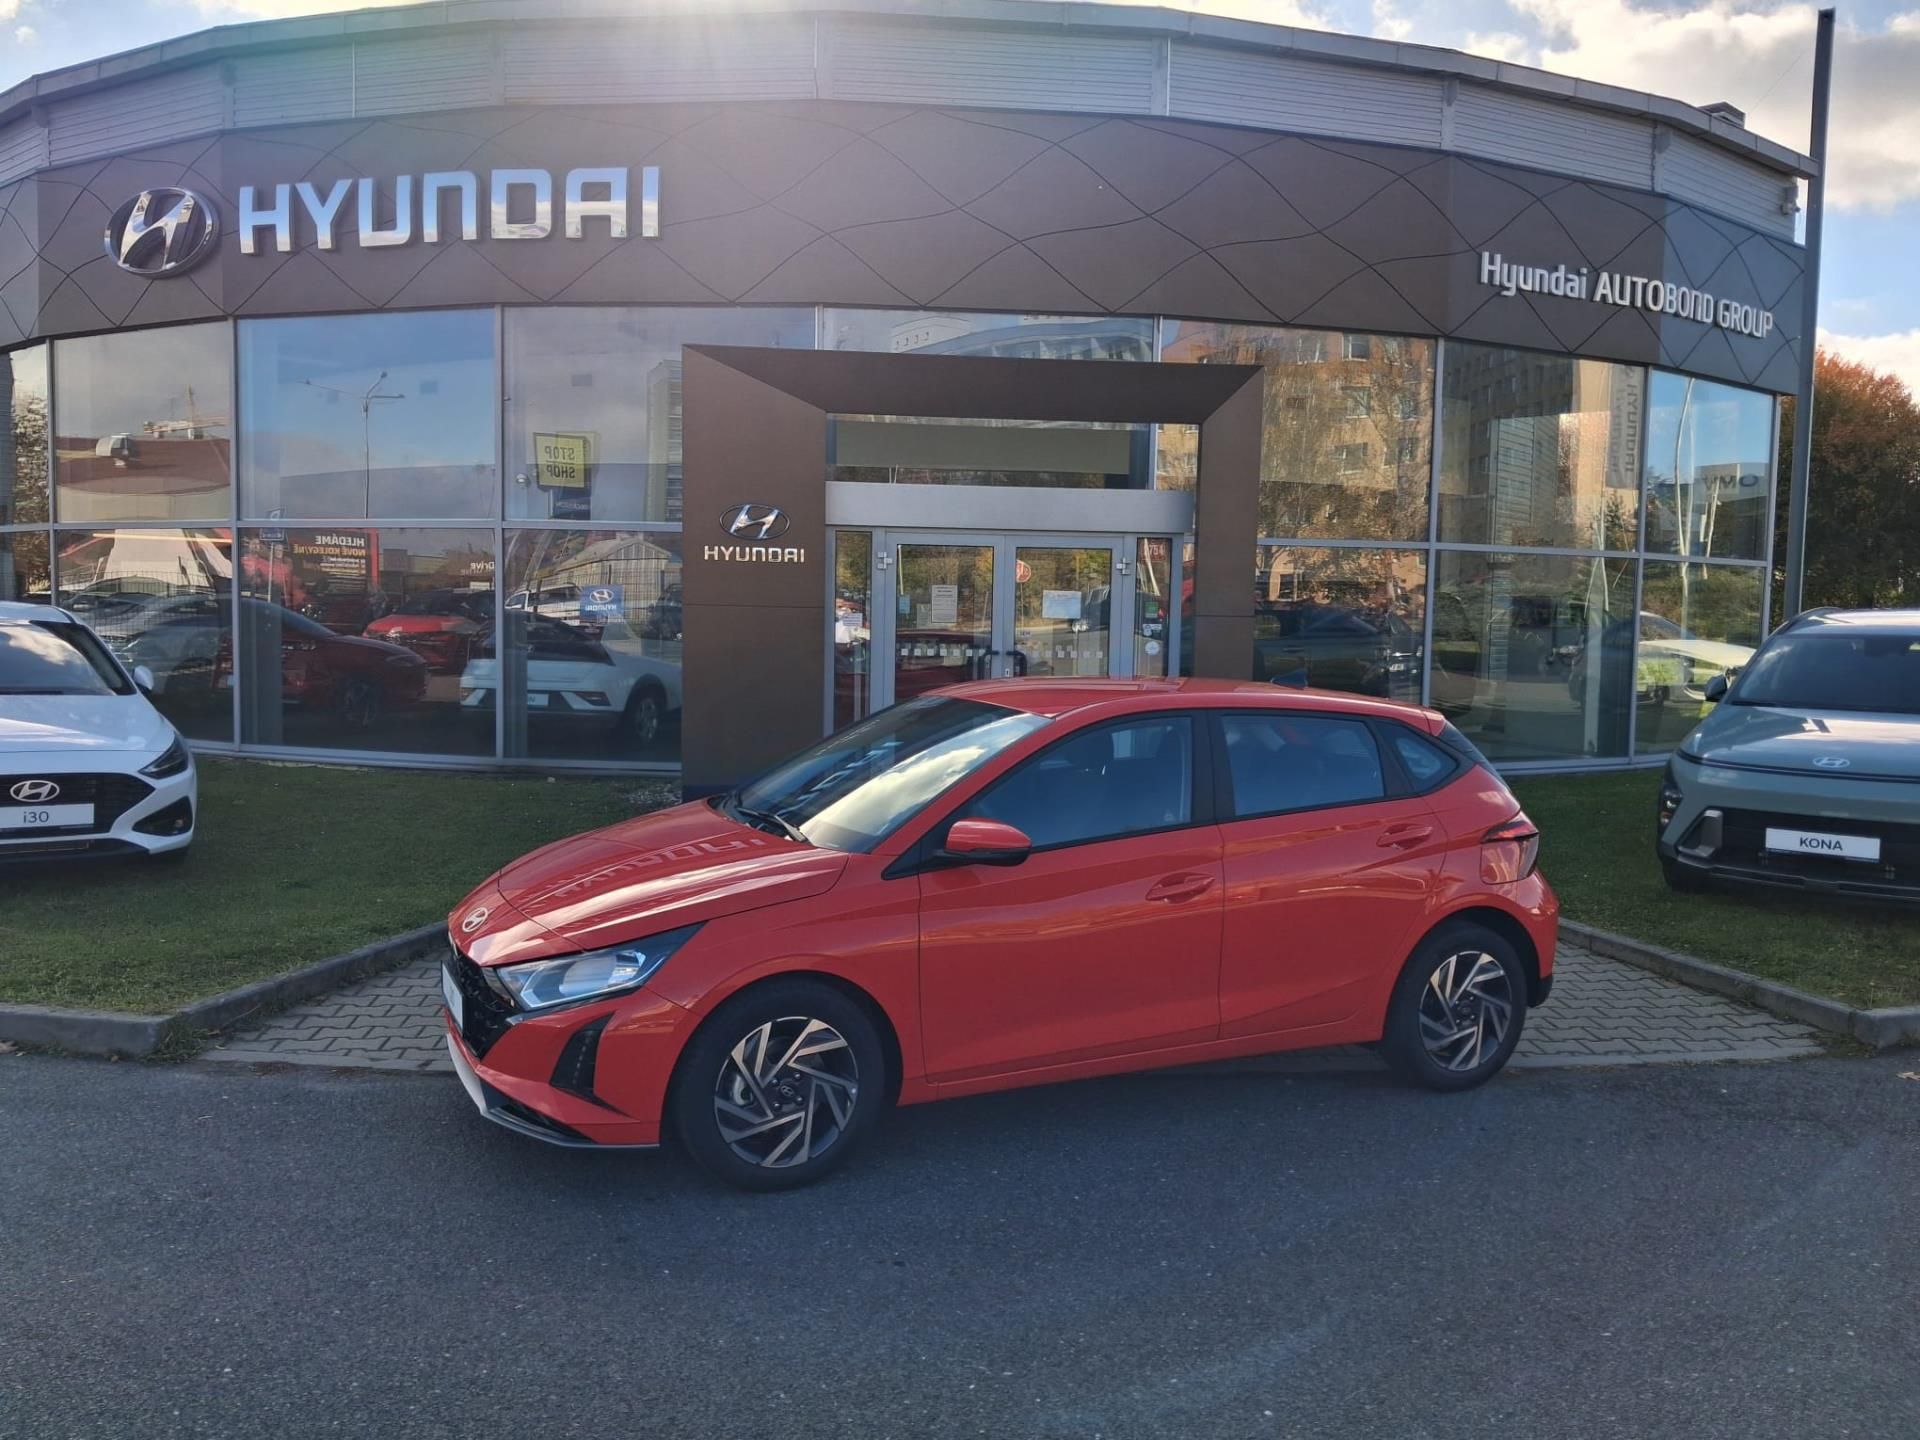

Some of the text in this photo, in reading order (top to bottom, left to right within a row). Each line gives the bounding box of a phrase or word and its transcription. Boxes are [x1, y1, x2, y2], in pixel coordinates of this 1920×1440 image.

[239, 165, 661, 255] HYUNDAI
[1480, 251, 1773, 338] Hyundai AUTOBOND GROUP
[704, 545, 805, 563] HYUNDAI
[23, 811, 49, 823] i30
[1800, 837, 1843, 851] KONA
